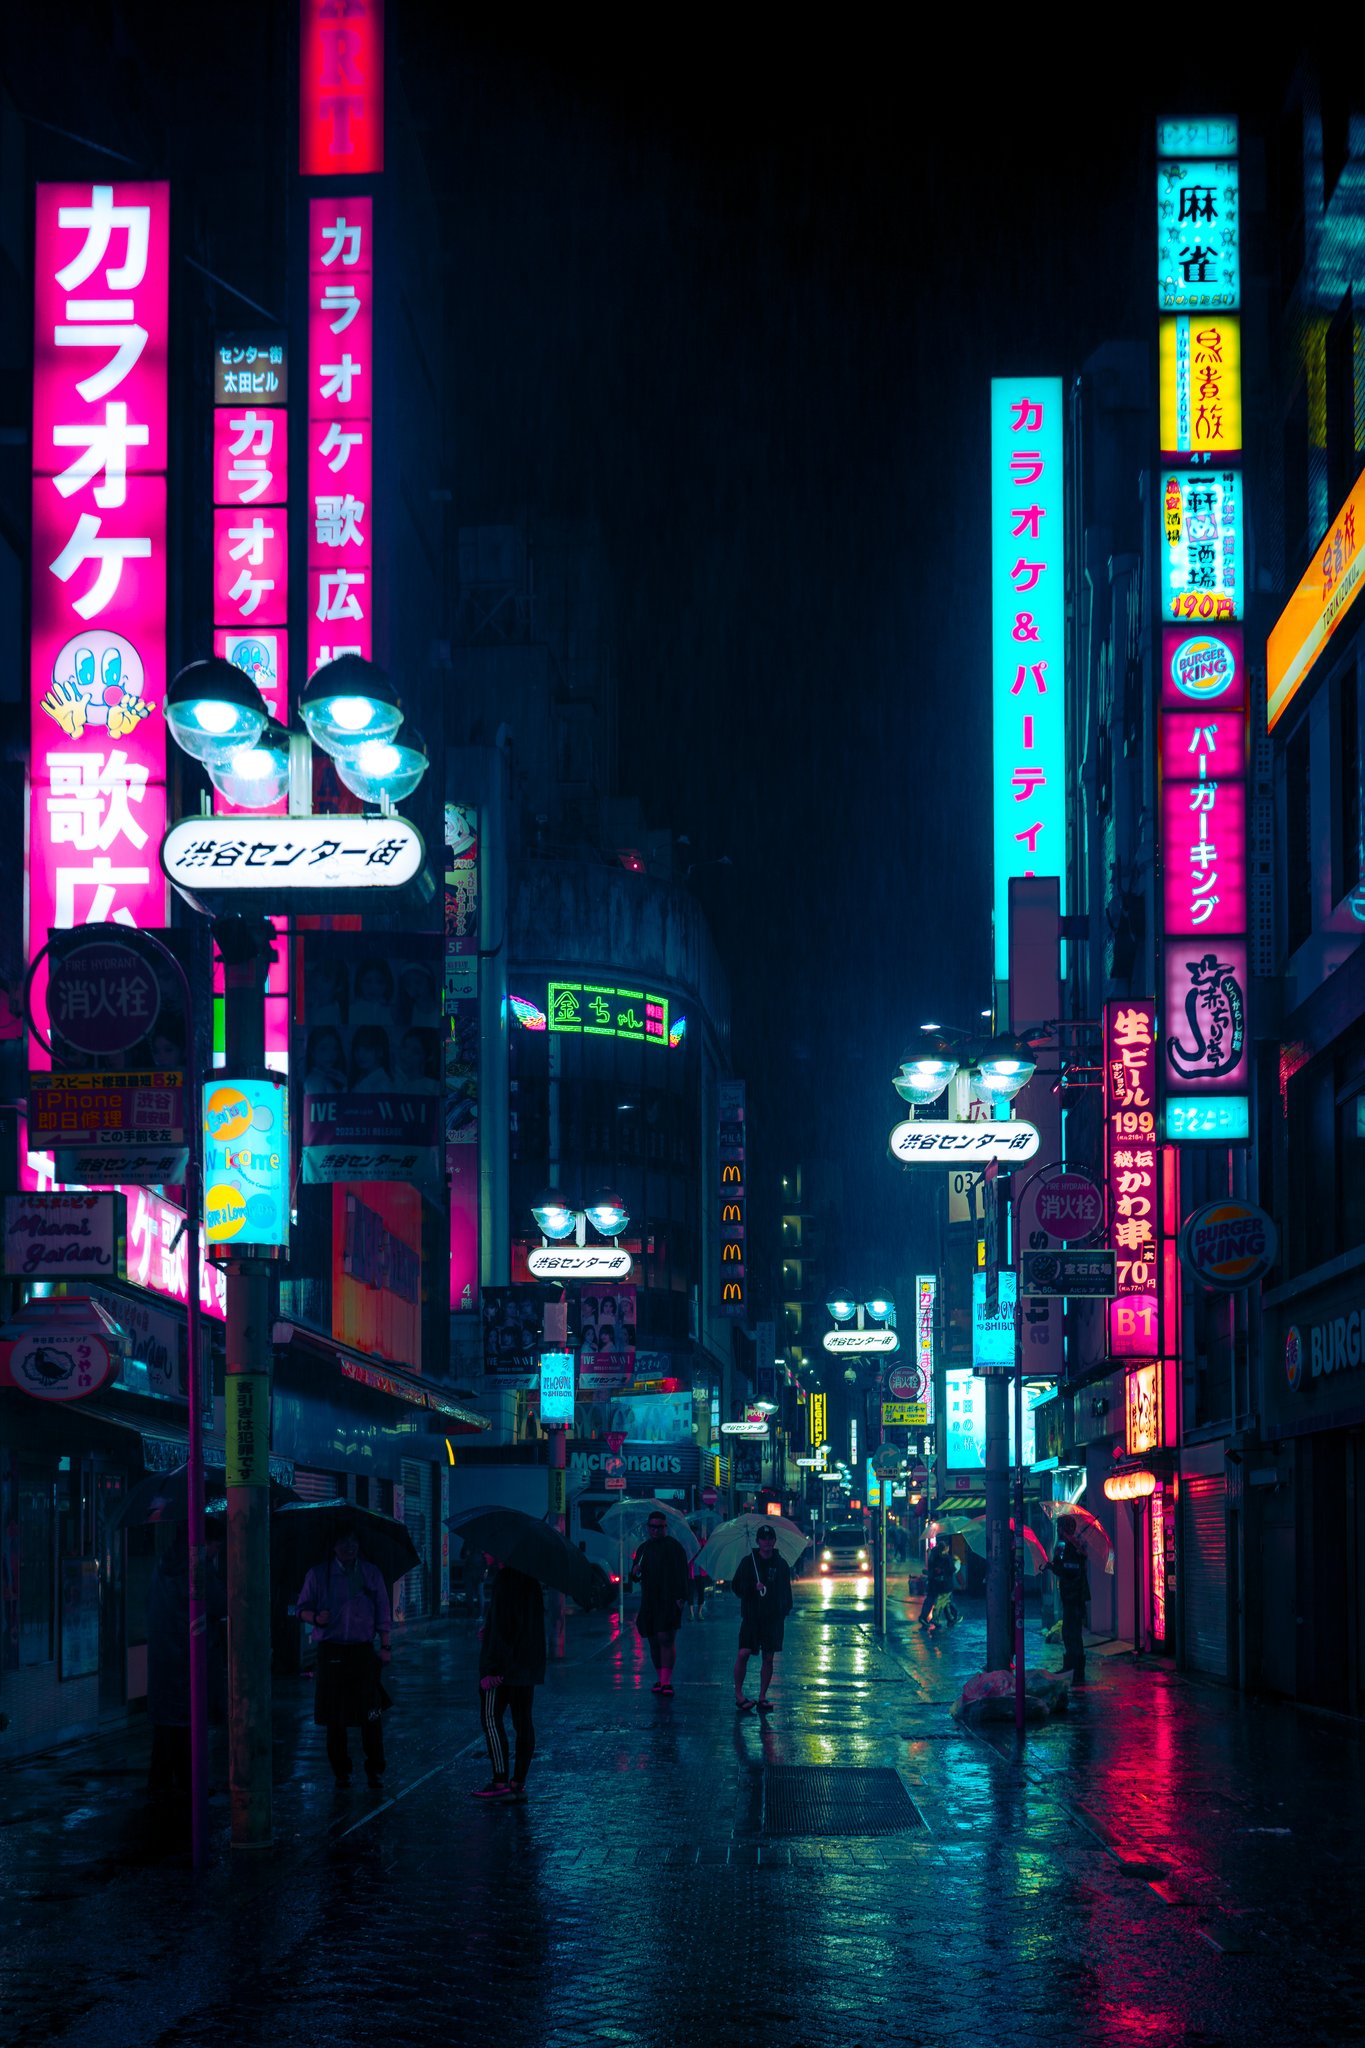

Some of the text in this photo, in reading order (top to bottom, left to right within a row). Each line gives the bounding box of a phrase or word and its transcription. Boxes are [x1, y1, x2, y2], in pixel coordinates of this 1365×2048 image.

[1177, 184, 1219, 284] 麻雀
[218, 345, 284, 366] センター街
[223, 371, 280, 395] 太田ビル
[1194, 327, 1224, 440] 鳥貴族
[48, 184, 152, 621] カラオケ
[227, 411, 276, 617] カラオケ
[1184, 476, 1218, 588] 一軒め酒場
[1171, 594, 1235, 619] 190円
[1010, 396, 1048, 877] カラオケ&パーティ
[1179, 648, 1226, 670] BURGER
[1181, 659, 1228, 686] KING
[1187, 723, 1221, 926] バーガーキング
[175, 838, 409, 868] 渋谷センター街
[65, 957, 137, 972] FIRE HYDRANT
[57, 975, 149, 1021] 消火栓
[554, 991, 644, 1029] 金ちゃん
[1113, 1008, 1152, 1107] 生ビール
[37, 1091, 123, 1110] iPhone
[310, 1102, 337, 1122] IVE
[37, 1110, 123, 1130] 即日修理
[100, 1129, 172, 1143] この手前を左
[898, 1133, 1034, 1150] 渋谷センター街
[75, 1156, 176, 1172] 渋谷センター街
[319, 1153, 420, 1169] 渋谷センター街
[1113, 1150, 1154, 1168] 秘伝
[1046, 1182, 1090, 1192] FIRE HYDRANT
[1040, 1194, 1097, 1220] 消火栓
[1115, 1170, 1153, 1251] かわ串
[9, 1215, 92, 1238] Miami
[1195, 1217, 1264, 1246] BURGER
[532, 1256, 626, 1269] 渋谷センター街
[1196, 1233, 1266, 1269] KING
[1116, 1307, 1153, 1337] B1
[826, 1335, 894, 1347] 渋谷センター街
[891, 1375, 919, 1389] 消火栓
